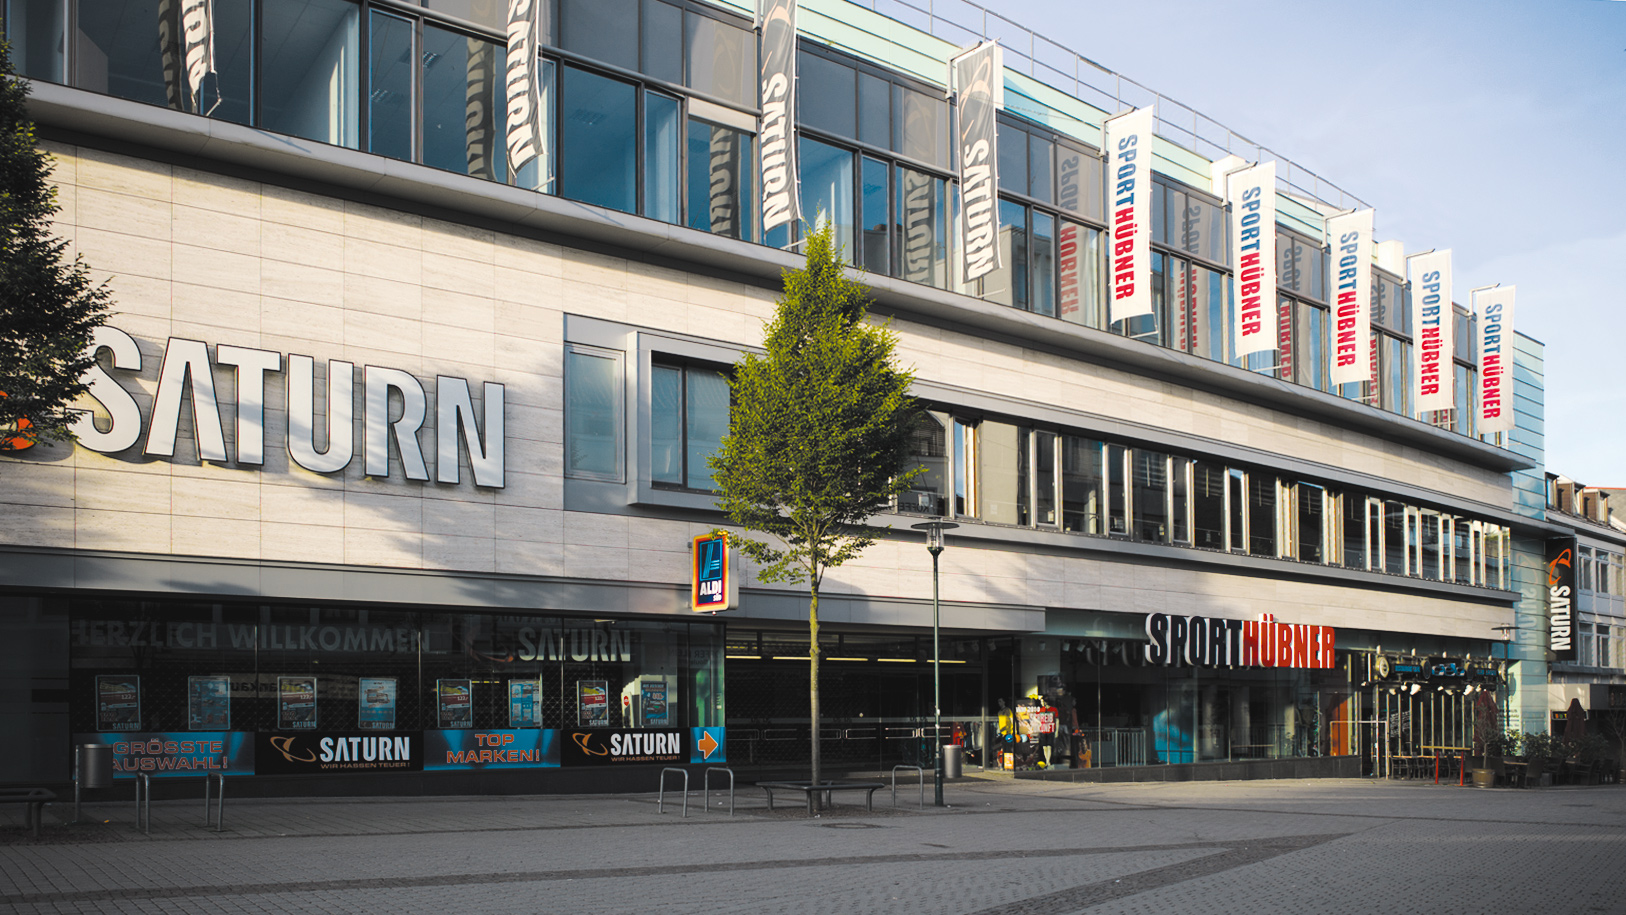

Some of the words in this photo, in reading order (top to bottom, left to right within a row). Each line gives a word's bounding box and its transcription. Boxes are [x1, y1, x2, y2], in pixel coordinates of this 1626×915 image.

[762, 72, 790, 232] SATURN
[963, 138, 995, 277] SATURN
[1115, 134, 1138, 300] SPORTHÜBNER
[1240, 186, 1264, 337] SPORTHÜBNER
[1337, 230, 1360, 367] SPORTHÜBNER
[1421, 271, 1444, 396] SPORTHÜBNER
[1483, 303, 1503, 420] SPORTHÜBNER
[65, 325, 506, 489] SATURN
[700, 580, 722, 596] ALDI
[1550, 585, 1571, 651] SATURN
[229, 624, 430, 652] WILLKOMMEN
[517, 627, 631, 663] SATURN
[1144, 613, 1335, 669] SPORTHÜBNER
[112, 738, 223, 755] GRÖSSTE
[320, 736, 410, 763] SATURN
[446, 749, 540, 764] MARKEN!
[475, 733, 515, 747] TOP
[610, 733, 680, 756] SATURN
